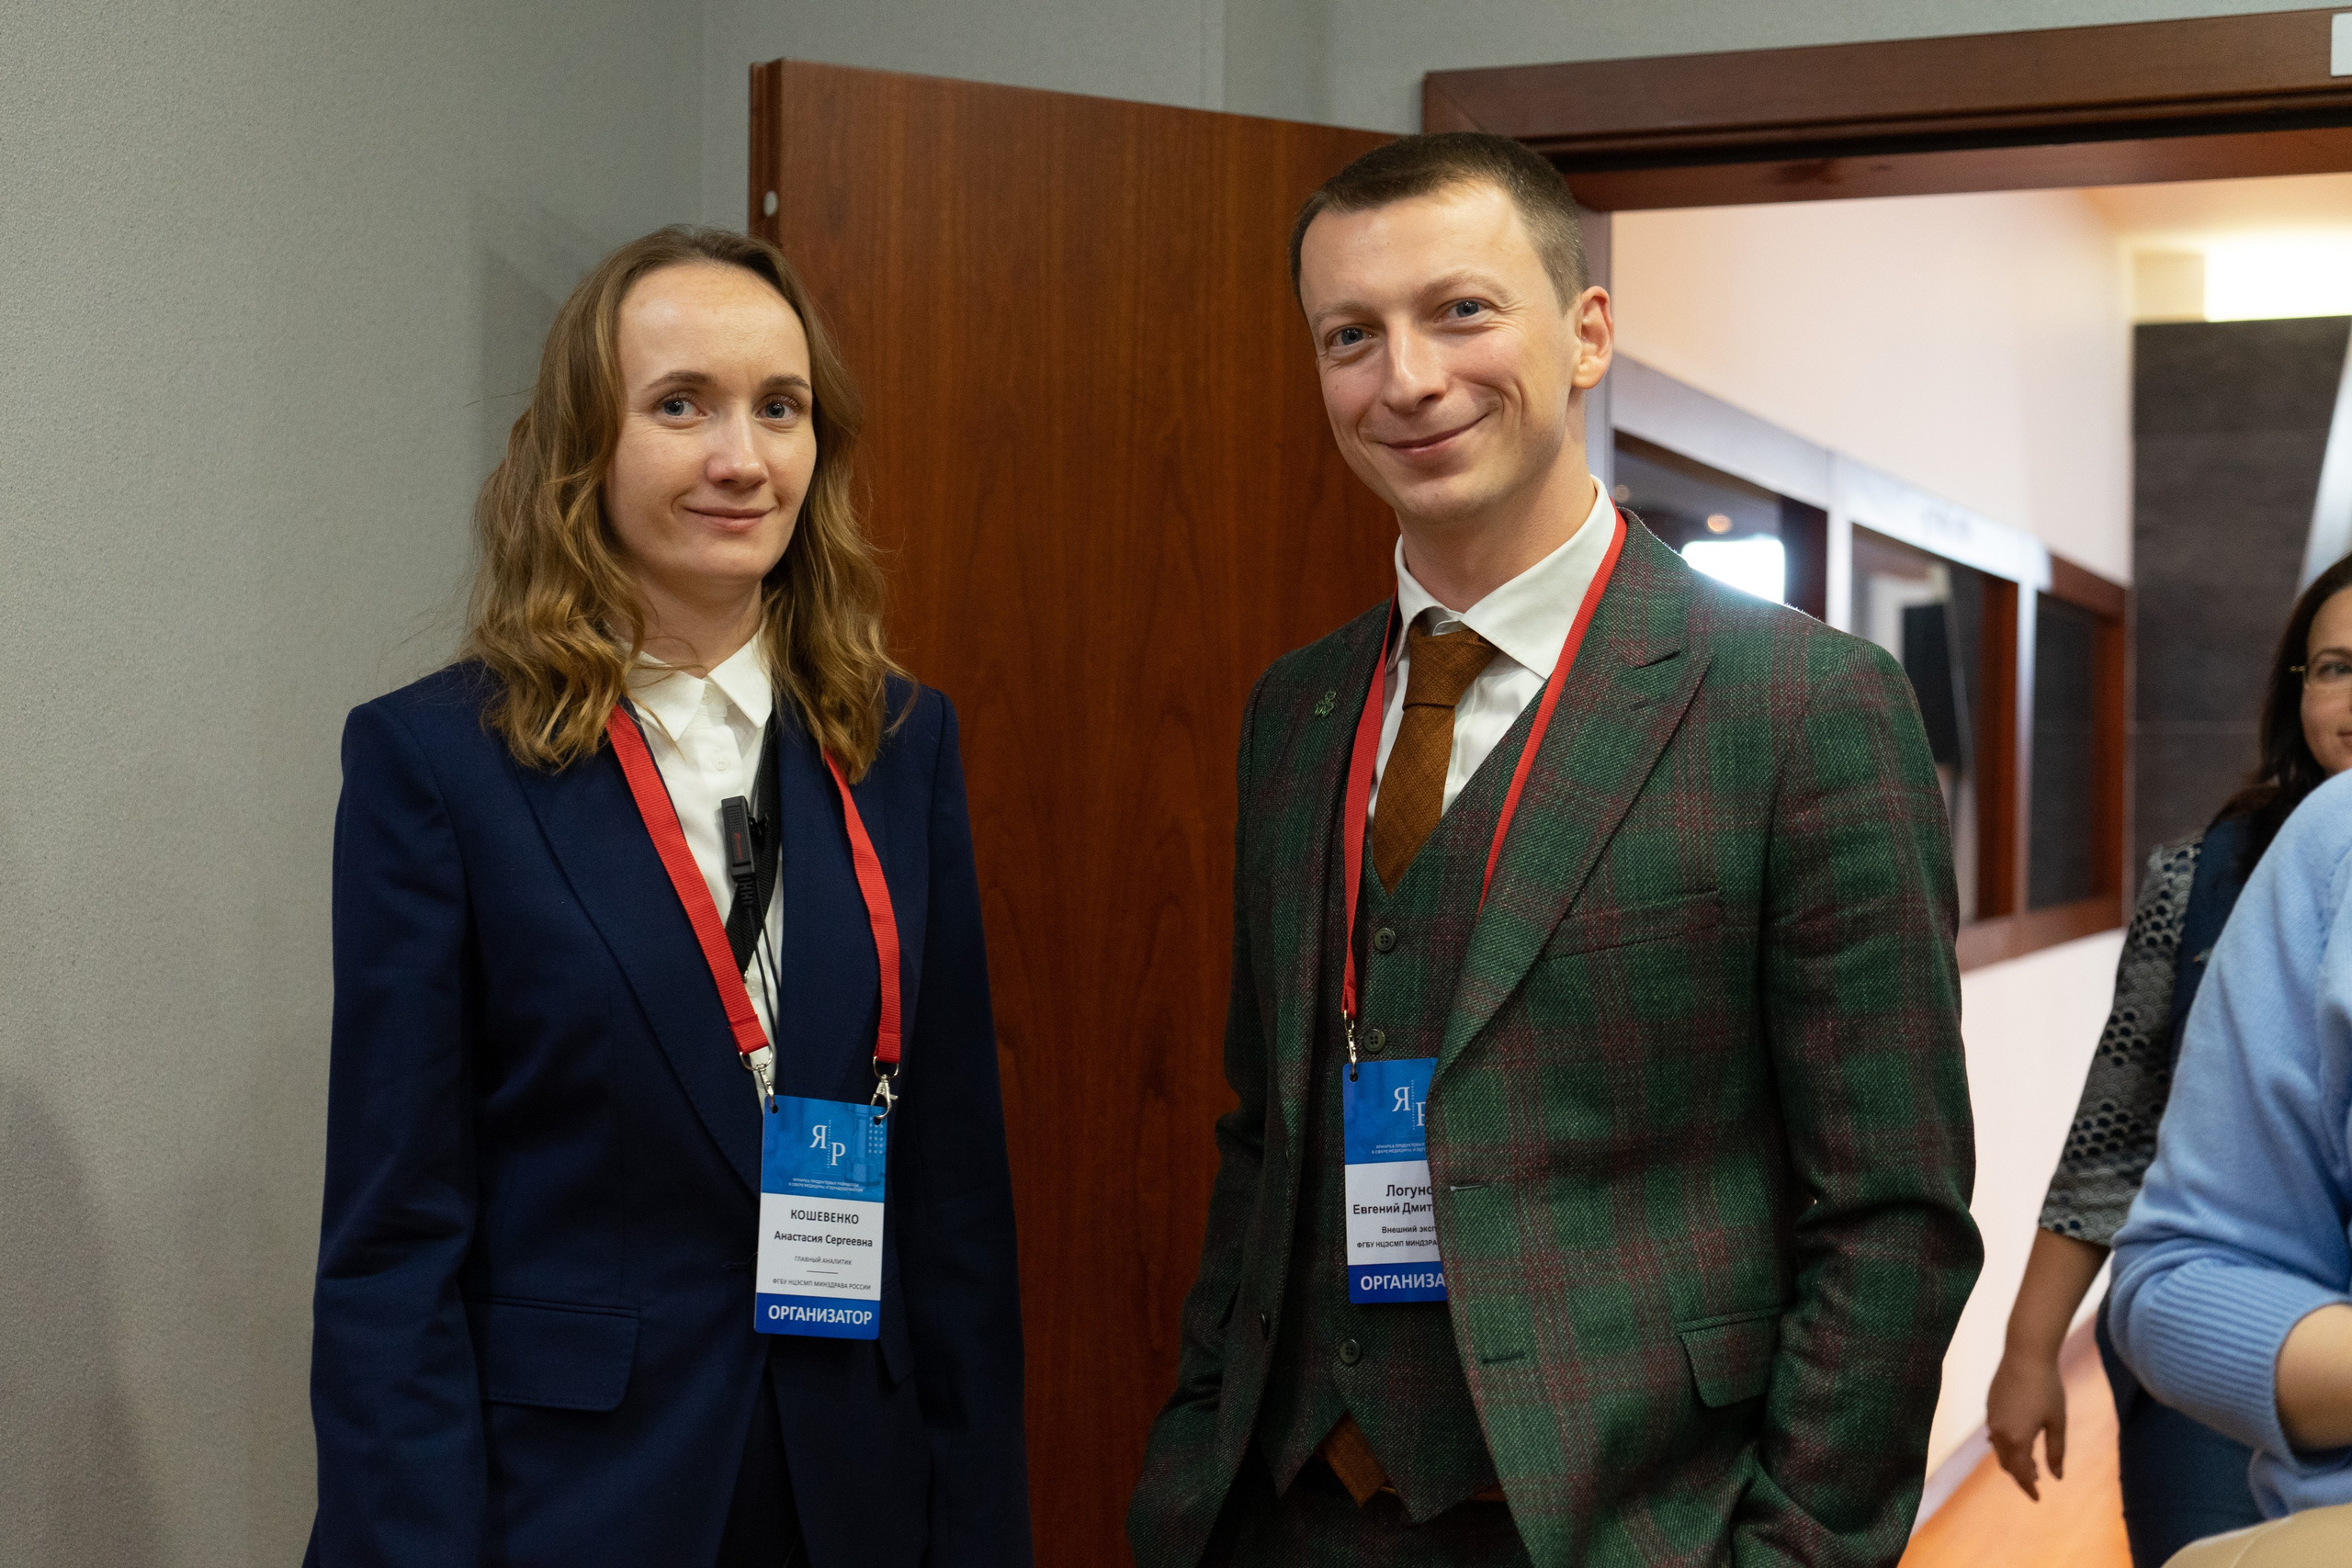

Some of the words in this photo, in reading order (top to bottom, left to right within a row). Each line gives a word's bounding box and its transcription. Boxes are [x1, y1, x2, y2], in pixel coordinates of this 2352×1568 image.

[1352, 1202, 1400, 1214] Евгений
[790, 1209, 859, 1224] КОШЕВЕНКО
[1381, 1224, 1418, 1234] Внешний
[774, 1230, 823, 1243] Анастасия
[825, 1235, 873, 1247] Сергеевна
[1375, 1240, 1404, 1248] НЦЭСМП
[814, 1280, 847, 1289] МИНЗДРАВА
[1360, 1272, 1446, 1291] ОРГАНИЗА
[768, 1304, 873, 1325] ОРГАНИЗАТОР
